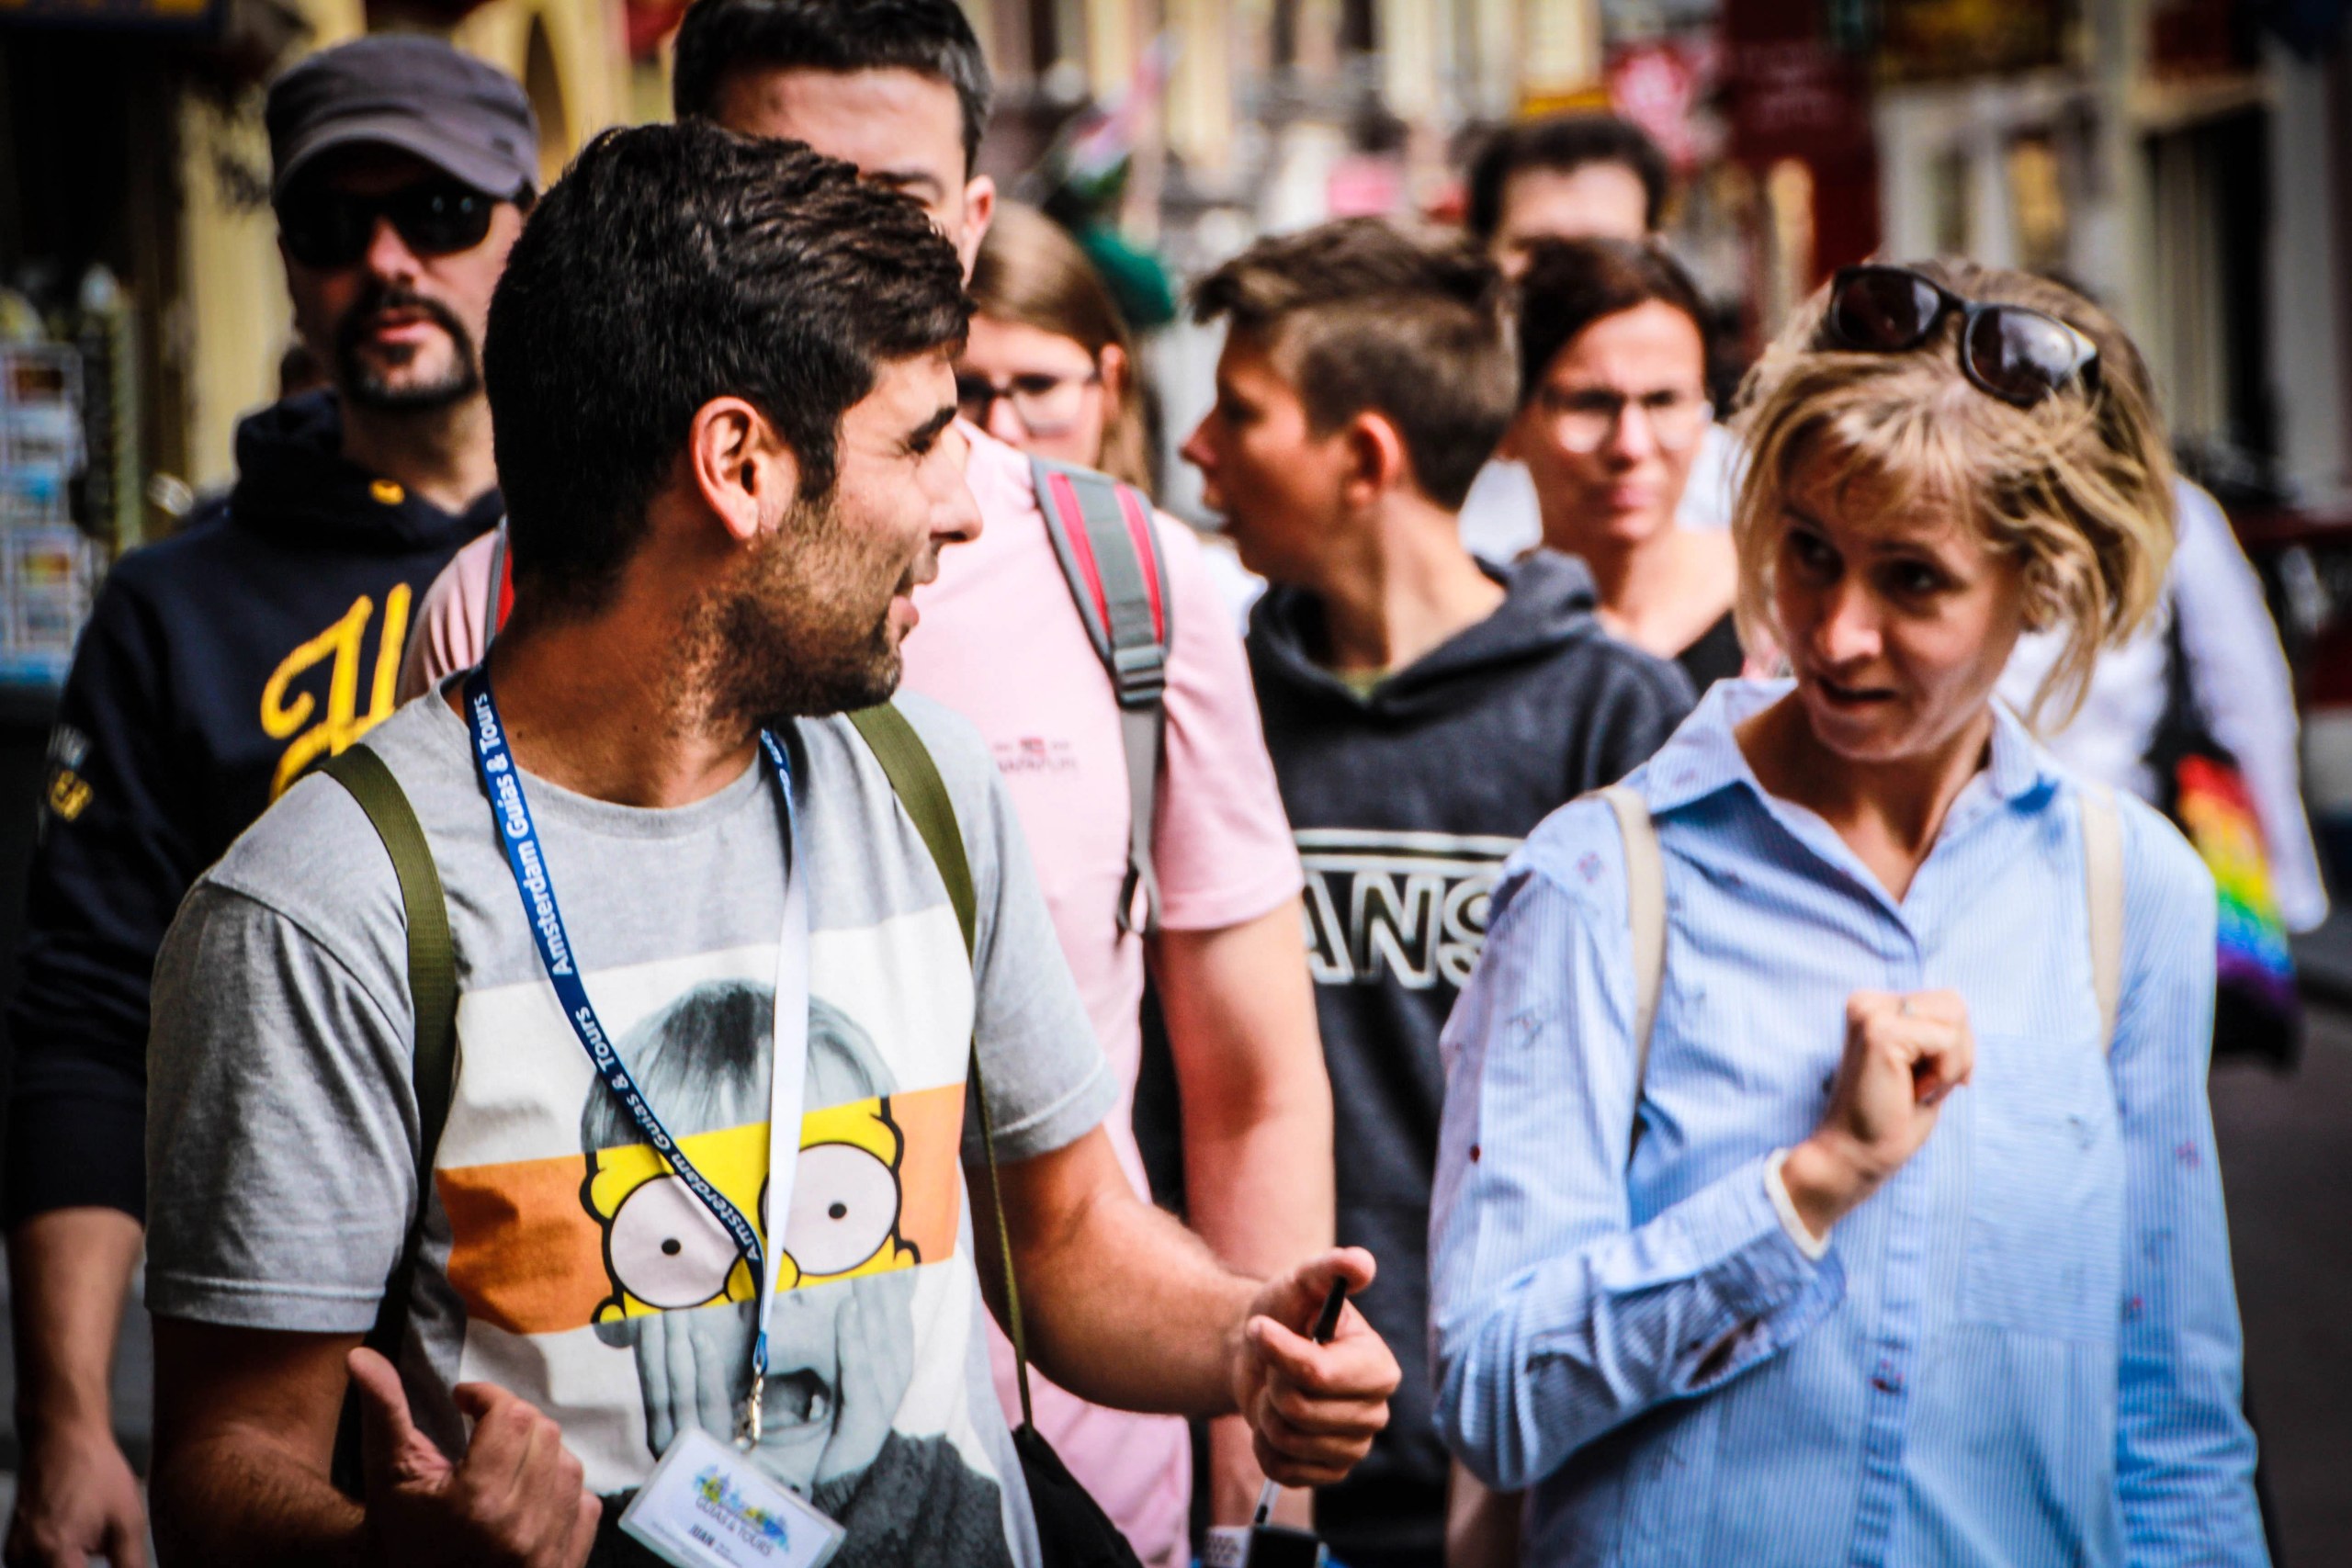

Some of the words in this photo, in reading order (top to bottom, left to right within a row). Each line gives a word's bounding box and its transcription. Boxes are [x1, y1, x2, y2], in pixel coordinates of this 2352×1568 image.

[473, 692, 502, 755] Tours
[486, 751, 509, 773] &
[517, 840, 573, 976] Amsterdam
[1301, 867, 1492, 989] ANS
[574, 1006, 616, 1072] Tours
[611, 1071, 629, 1091] &
[671, 1153, 761, 1261] Amsterdam
